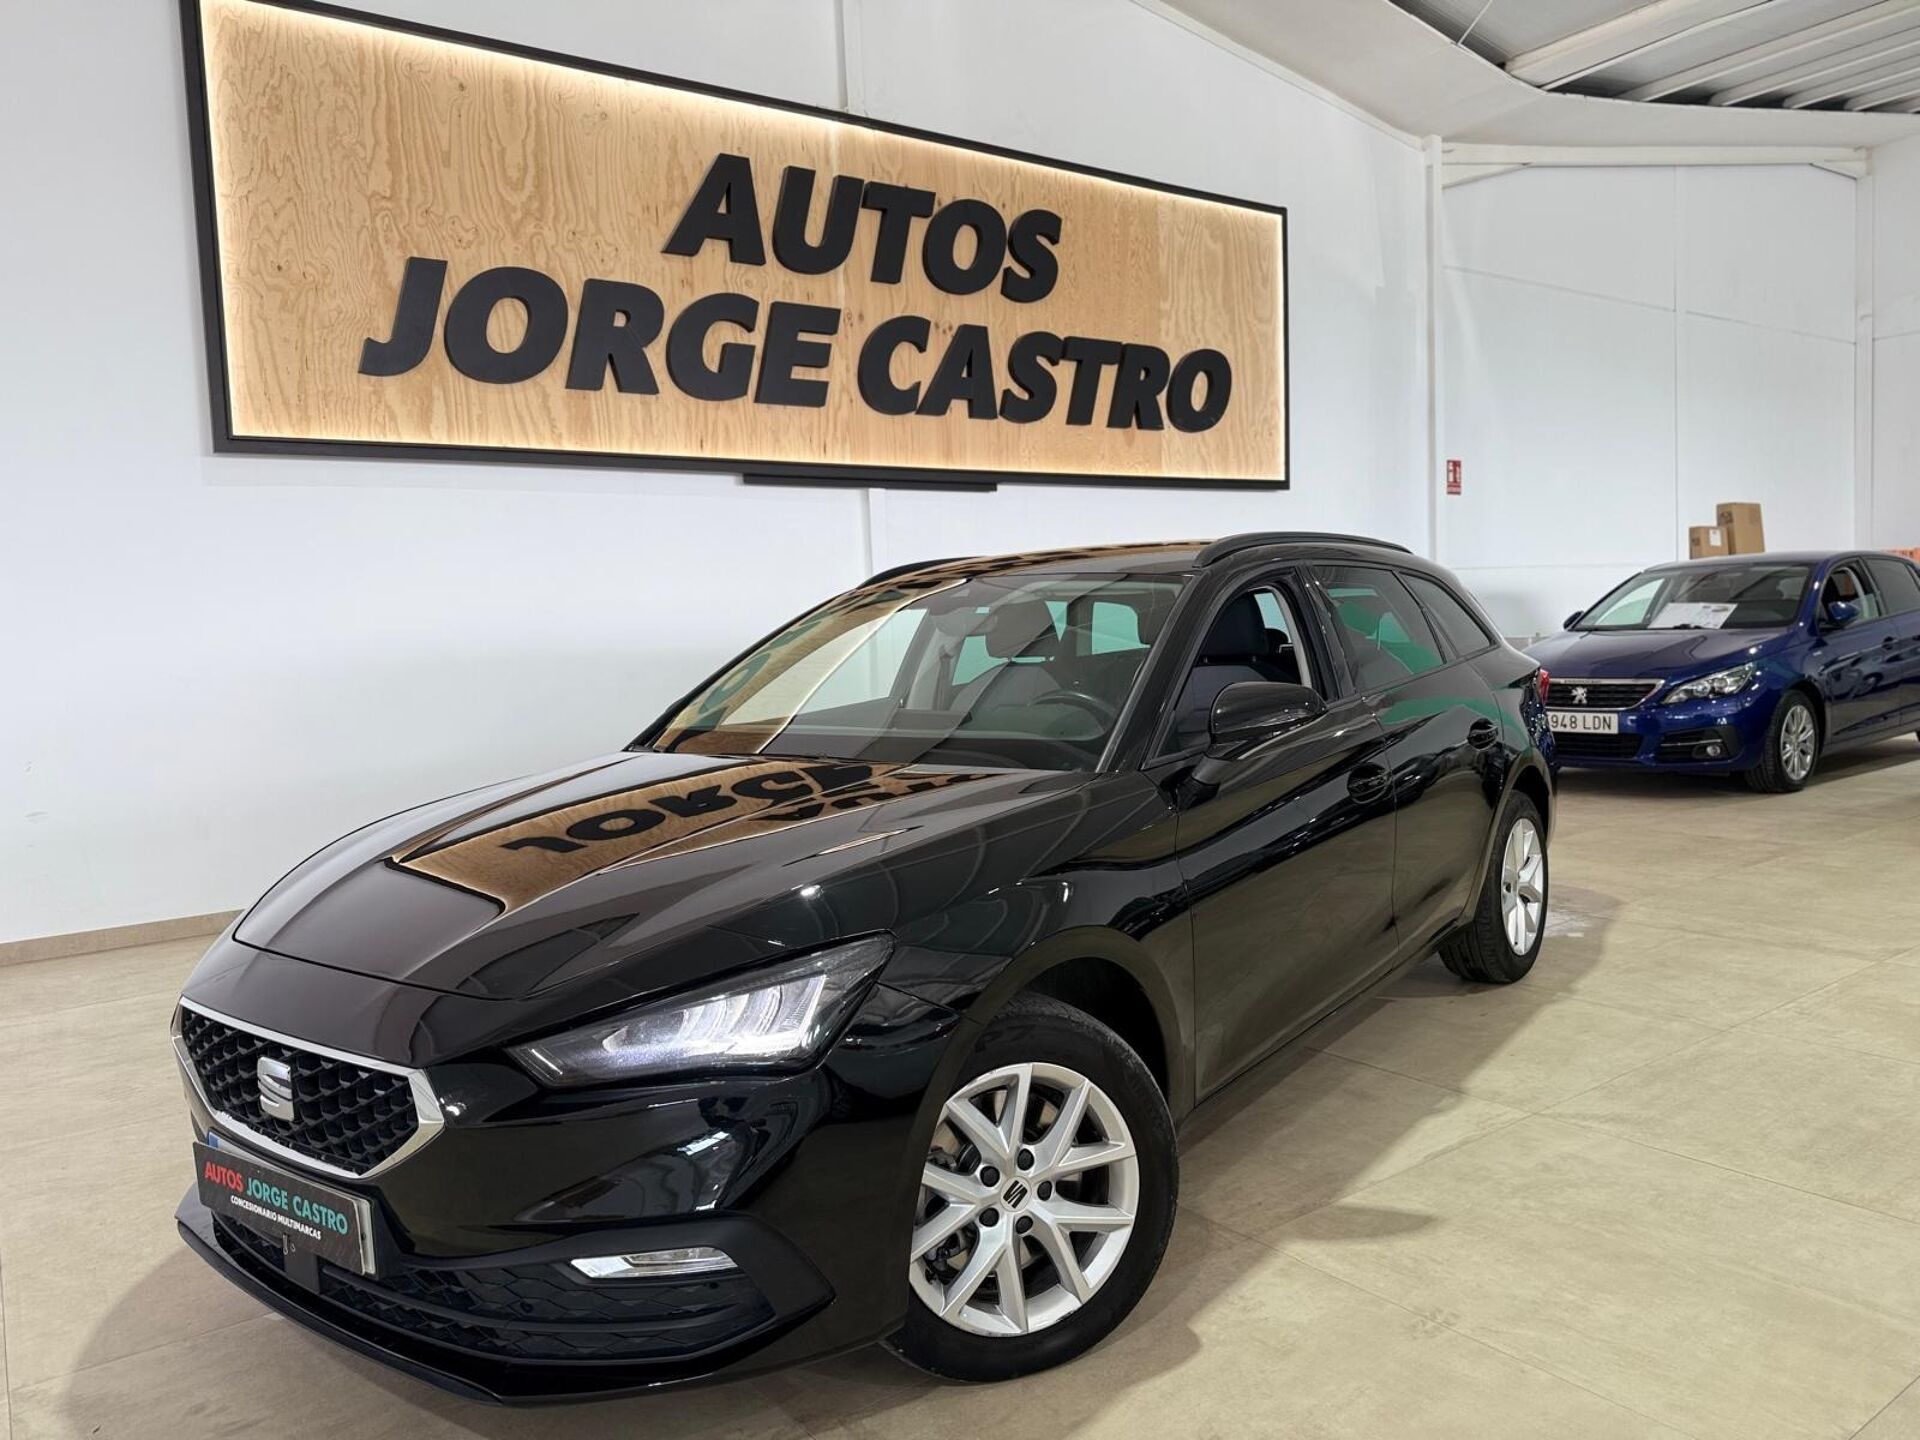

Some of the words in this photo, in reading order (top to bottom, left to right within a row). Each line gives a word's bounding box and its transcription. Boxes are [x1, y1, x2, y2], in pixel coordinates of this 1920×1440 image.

[662, 153, 1062, 304] AUTOS
[358, 256, 842, 407] JORGE
[857, 315, 1233, 433] CASTRO
[1550, 714, 1578, 730] 948
[1582, 715, 1612, 731] LDN
[204, 1160, 244, 1193] AUTOS
[246, 1177, 289, 1212] JORGE
[292, 1195, 348, 1235] CASTRO
[230, 1195, 277, 1222] CONCESIONARIO
[277, 1213, 322, 1240] MULTIMARCAS
